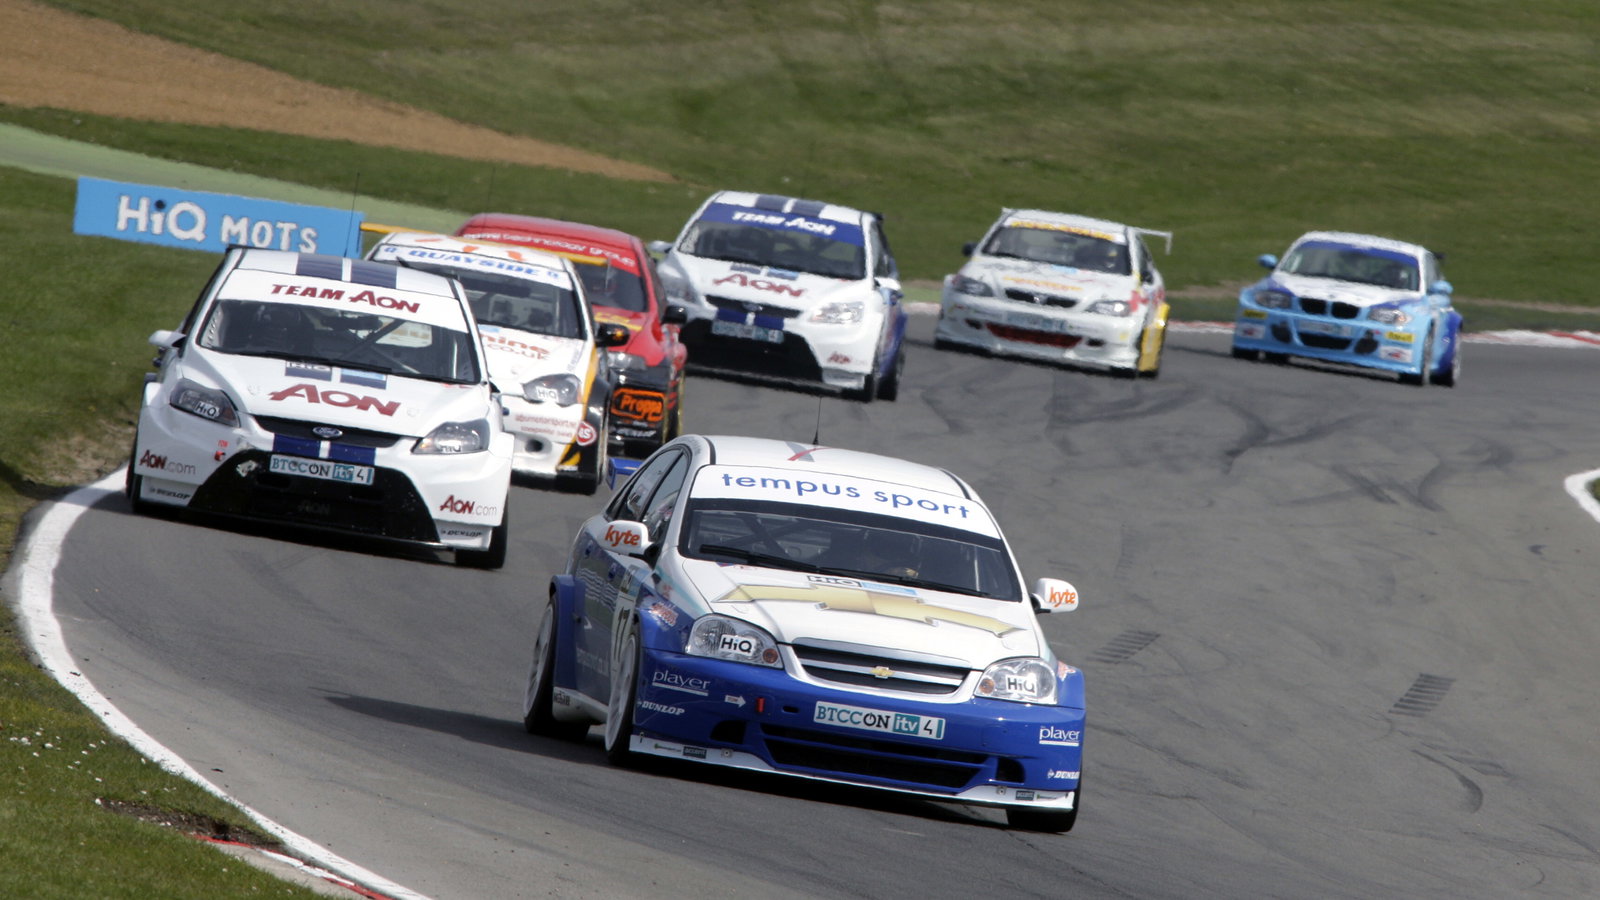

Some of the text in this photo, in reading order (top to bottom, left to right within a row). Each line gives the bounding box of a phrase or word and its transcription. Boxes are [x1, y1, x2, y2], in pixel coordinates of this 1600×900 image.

[116, 195, 319, 254] HiQ MOTS
[732, 212, 785, 224] TEAM
[408, 249, 539, 275] QUAYSIDE
[713, 274, 805, 297] AON
[271, 284, 421, 313] TEAM AON
[196, 402, 217, 417] HiQ
[268, 383, 401, 417] AON
[140, 449, 196, 475] AON.com
[271, 457, 331, 477] BTCCON
[356, 468, 364, 481] 4
[440, 494, 497, 516] AON.com
[722, 473, 970, 519] tempus sport
[604, 525, 640, 547] kyte
[1049, 586, 1076, 608] kyte
[721, 637, 752, 653] HiQ
[652, 670, 711, 690] player
[1007, 677, 1035, 694] HiQ
[641, 701, 685, 715] DUNLOP
[816, 706, 933, 735] BTCCON itv 4
[1039, 726, 1080, 742] player
